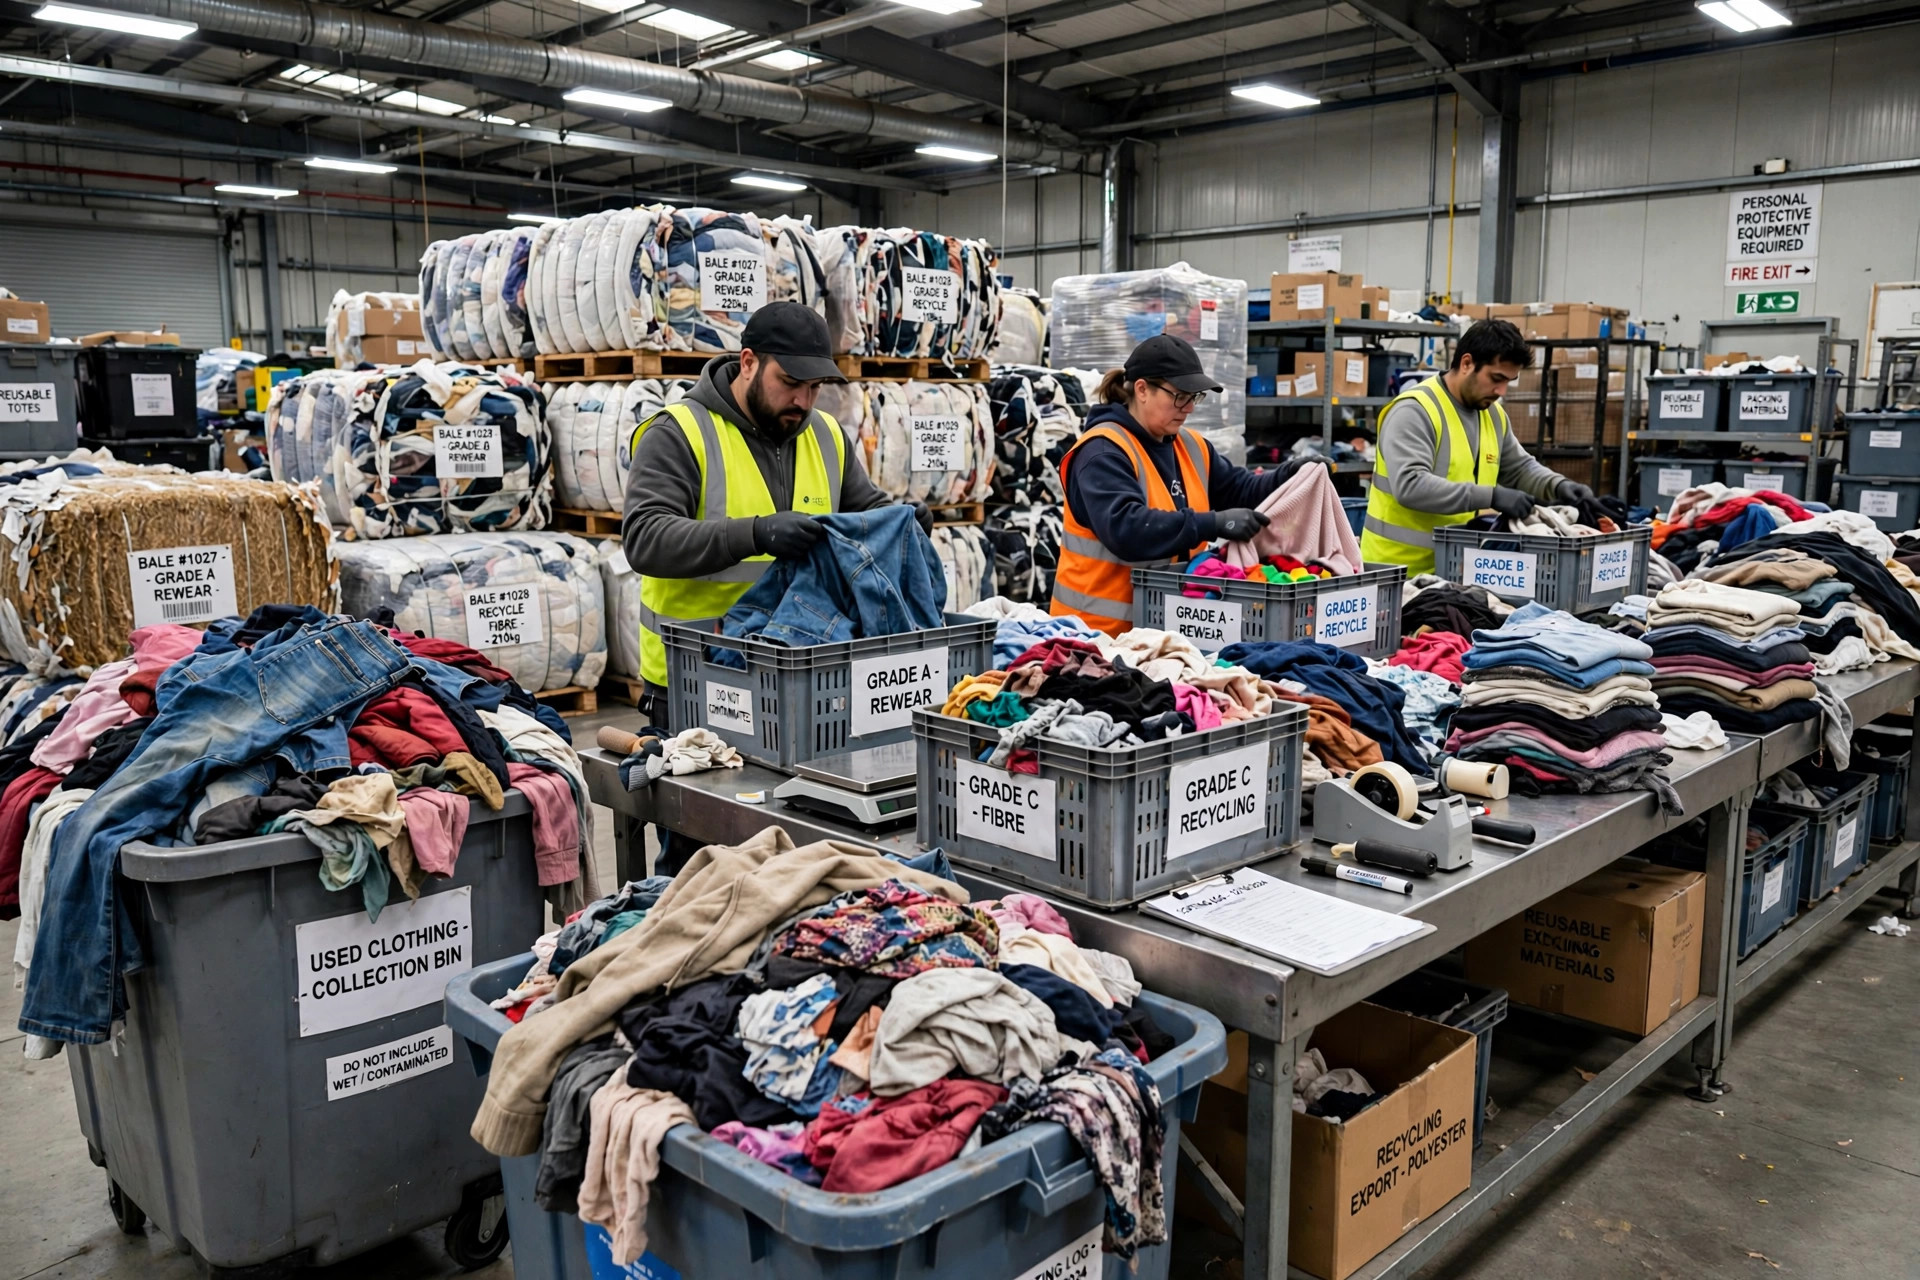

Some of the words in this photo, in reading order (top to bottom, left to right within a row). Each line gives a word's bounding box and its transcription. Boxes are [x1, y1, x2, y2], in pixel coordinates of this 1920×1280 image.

[1742, 193, 1808, 209] PERSONAL
[1736, 207, 1812, 225] PROTECTIVE
[1737, 223, 1810, 240] EQUIPMENT
[1740, 238, 1804, 254] REQUIRED
[705, 257, 729, 268] BALE
[731, 260, 758, 270] #1027
[714, 271, 747, 283] GRADE
[749, 273, 755, 283] A
[906, 273, 927, 284] BALE
[1731, 266, 1759, 281] FIRE
[1763, 264, 1792, 280] EXIT
[714, 285, 753, 296] REWEAR
[913, 286, 940, 298] GRADE
[943, 288, 949, 298] B
[912, 299, 947, 311] RECYCLE
[7, 403, 41, 413] TOTES
[1669, 404, 1693, 413] TOTES
[439, 429, 463, 439] BALE
[914, 420, 934, 431] BALE
[447, 441, 481, 450] GRADE
[920, 433, 948, 443] GRADE
[950, 433, 956, 443] C
[448, 453, 486, 462] REWEAR
[138, 555, 174, 570] BALE
[178, 551, 218, 566] #1027
[1474, 557, 1513, 571] GRADE
[1516, 560, 1524, 571] B
[154, 569, 203, 585] GRADE
[206, 568, 215, 581] A
[1474, 573, 1525, 588] RECYCLE
[154, 584, 212, 602] REWEAR
[469, 592, 496, 606] BALE
[499, 589, 530, 601] #1028
[478, 603, 525, 619] RECYCLE
[1176, 605, 1216, 623] GRADE
[1218, 610, 1227, 624] A
[1325, 598, 1358, 617] GRADE
[1360, 597, 1367, 613] B
[489, 618, 518, 632] FIBRE
[1179, 624, 1226, 643] REWEAR
[1324, 617, 1368, 639] RECYCLE
[866, 665, 918, 690] GRADE
[921, 663, 931, 680] A
[716, 689, 726, 701] DO
[870, 688, 932, 715] REWEAR
[968, 774, 1023, 806] GRADE
[1027, 789, 1039, 810] C
[1185, 769, 1236, 802] GRADE
[1240, 765, 1251, 787] C
[981, 804, 1026, 834] FIBRE
[1180, 793, 1256, 835] RECYCLING
[1524, 909, 1611, 942] REUSABLE
[310, 944, 362, 972] USED
[368, 919, 459, 959] CLOTHING
[312, 954, 429, 1000] COLLECTION
[434, 945, 462, 969] BIN
[1520, 947, 1615, 983] MATERIALS
[343, 1059, 360, 1074] DO
[363, 1053, 386, 1069] NOT
[389, 1036, 436, 1061] INCLUDE
[333, 1074, 358, 1091] WET
[367, 1046, 449, 1082] CONTAMINATED
[1376, 1108, 1442, 1169] RECYCLING
[1350, 1165, 1399, 1217] EXPORT
[1407, 1117, 1467, 1177] POLYESTER
[1066, 1243, 1089, 1270] LOG
